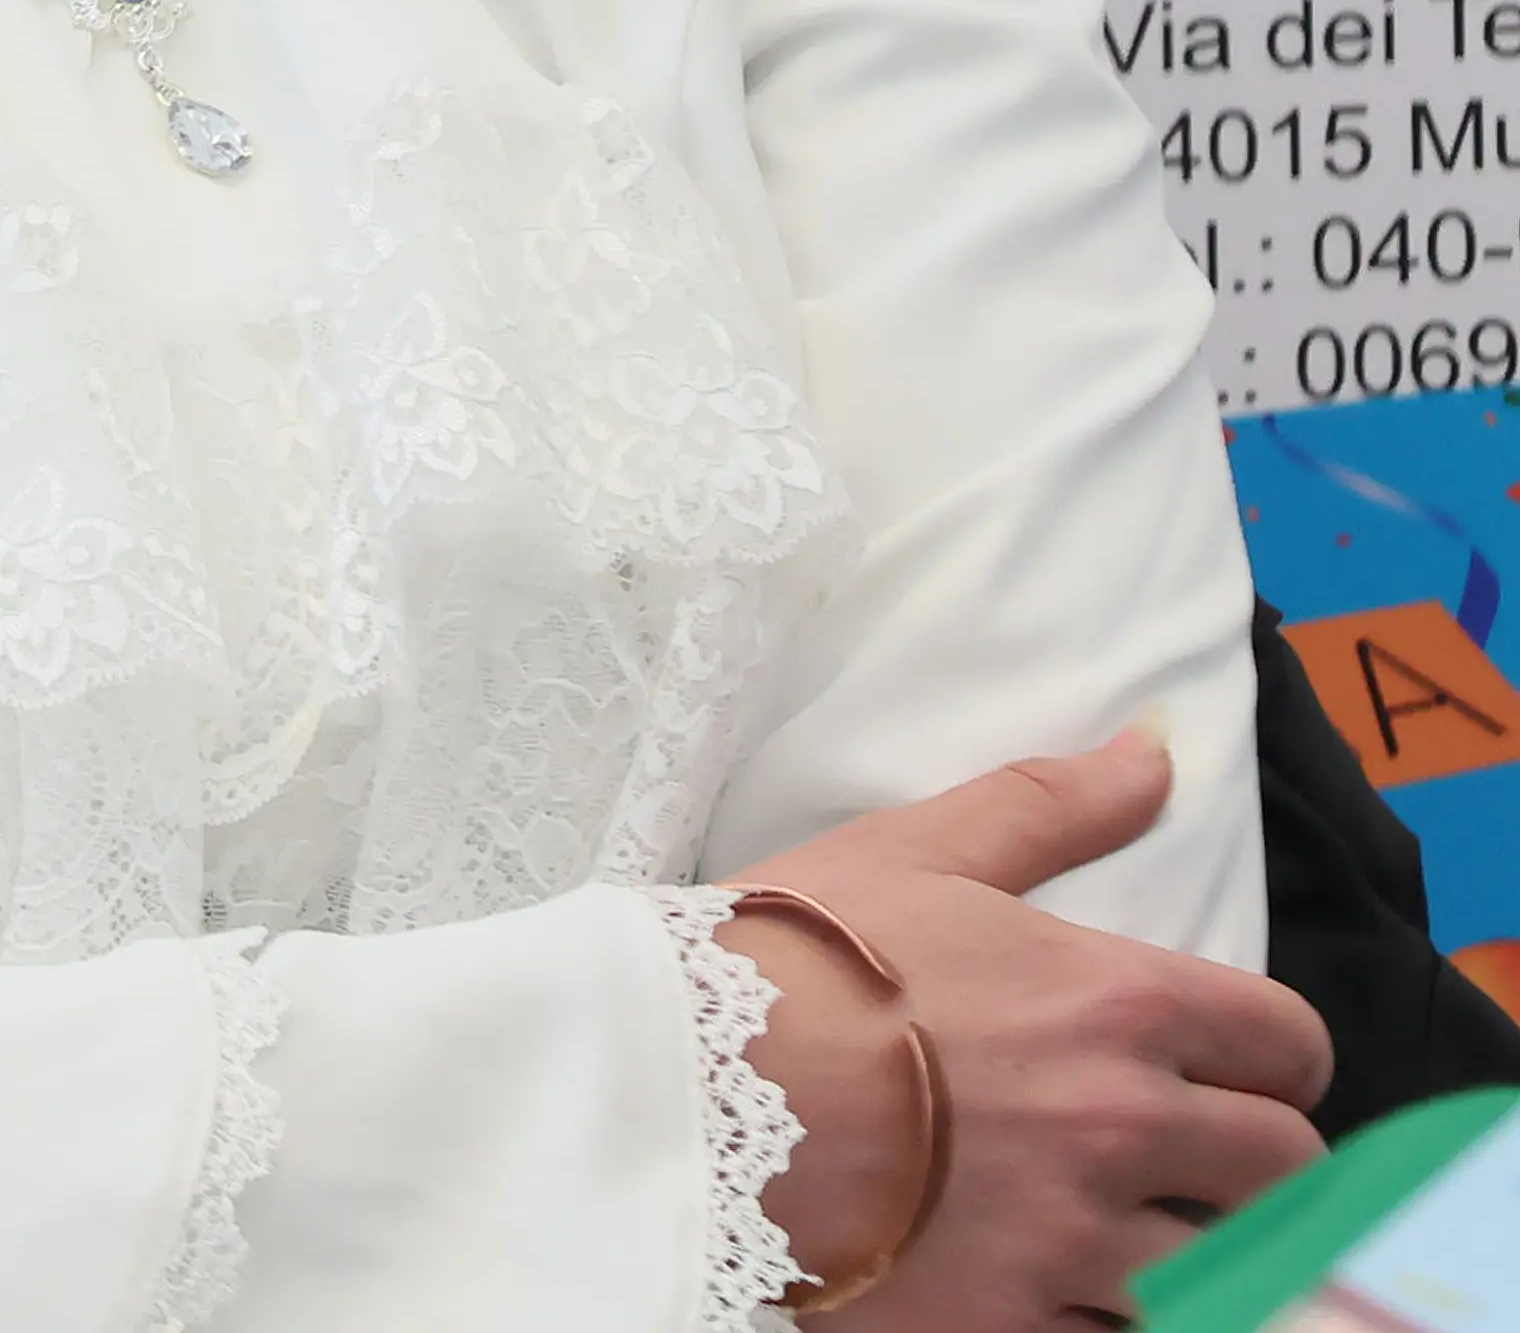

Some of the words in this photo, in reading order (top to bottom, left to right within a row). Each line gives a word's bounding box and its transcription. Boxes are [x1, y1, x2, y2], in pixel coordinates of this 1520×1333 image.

[1311, 208, 1520, 291] 040-
[1295, 318, 1519, 406] 0069
[1357, 636, 1508, 759] A
